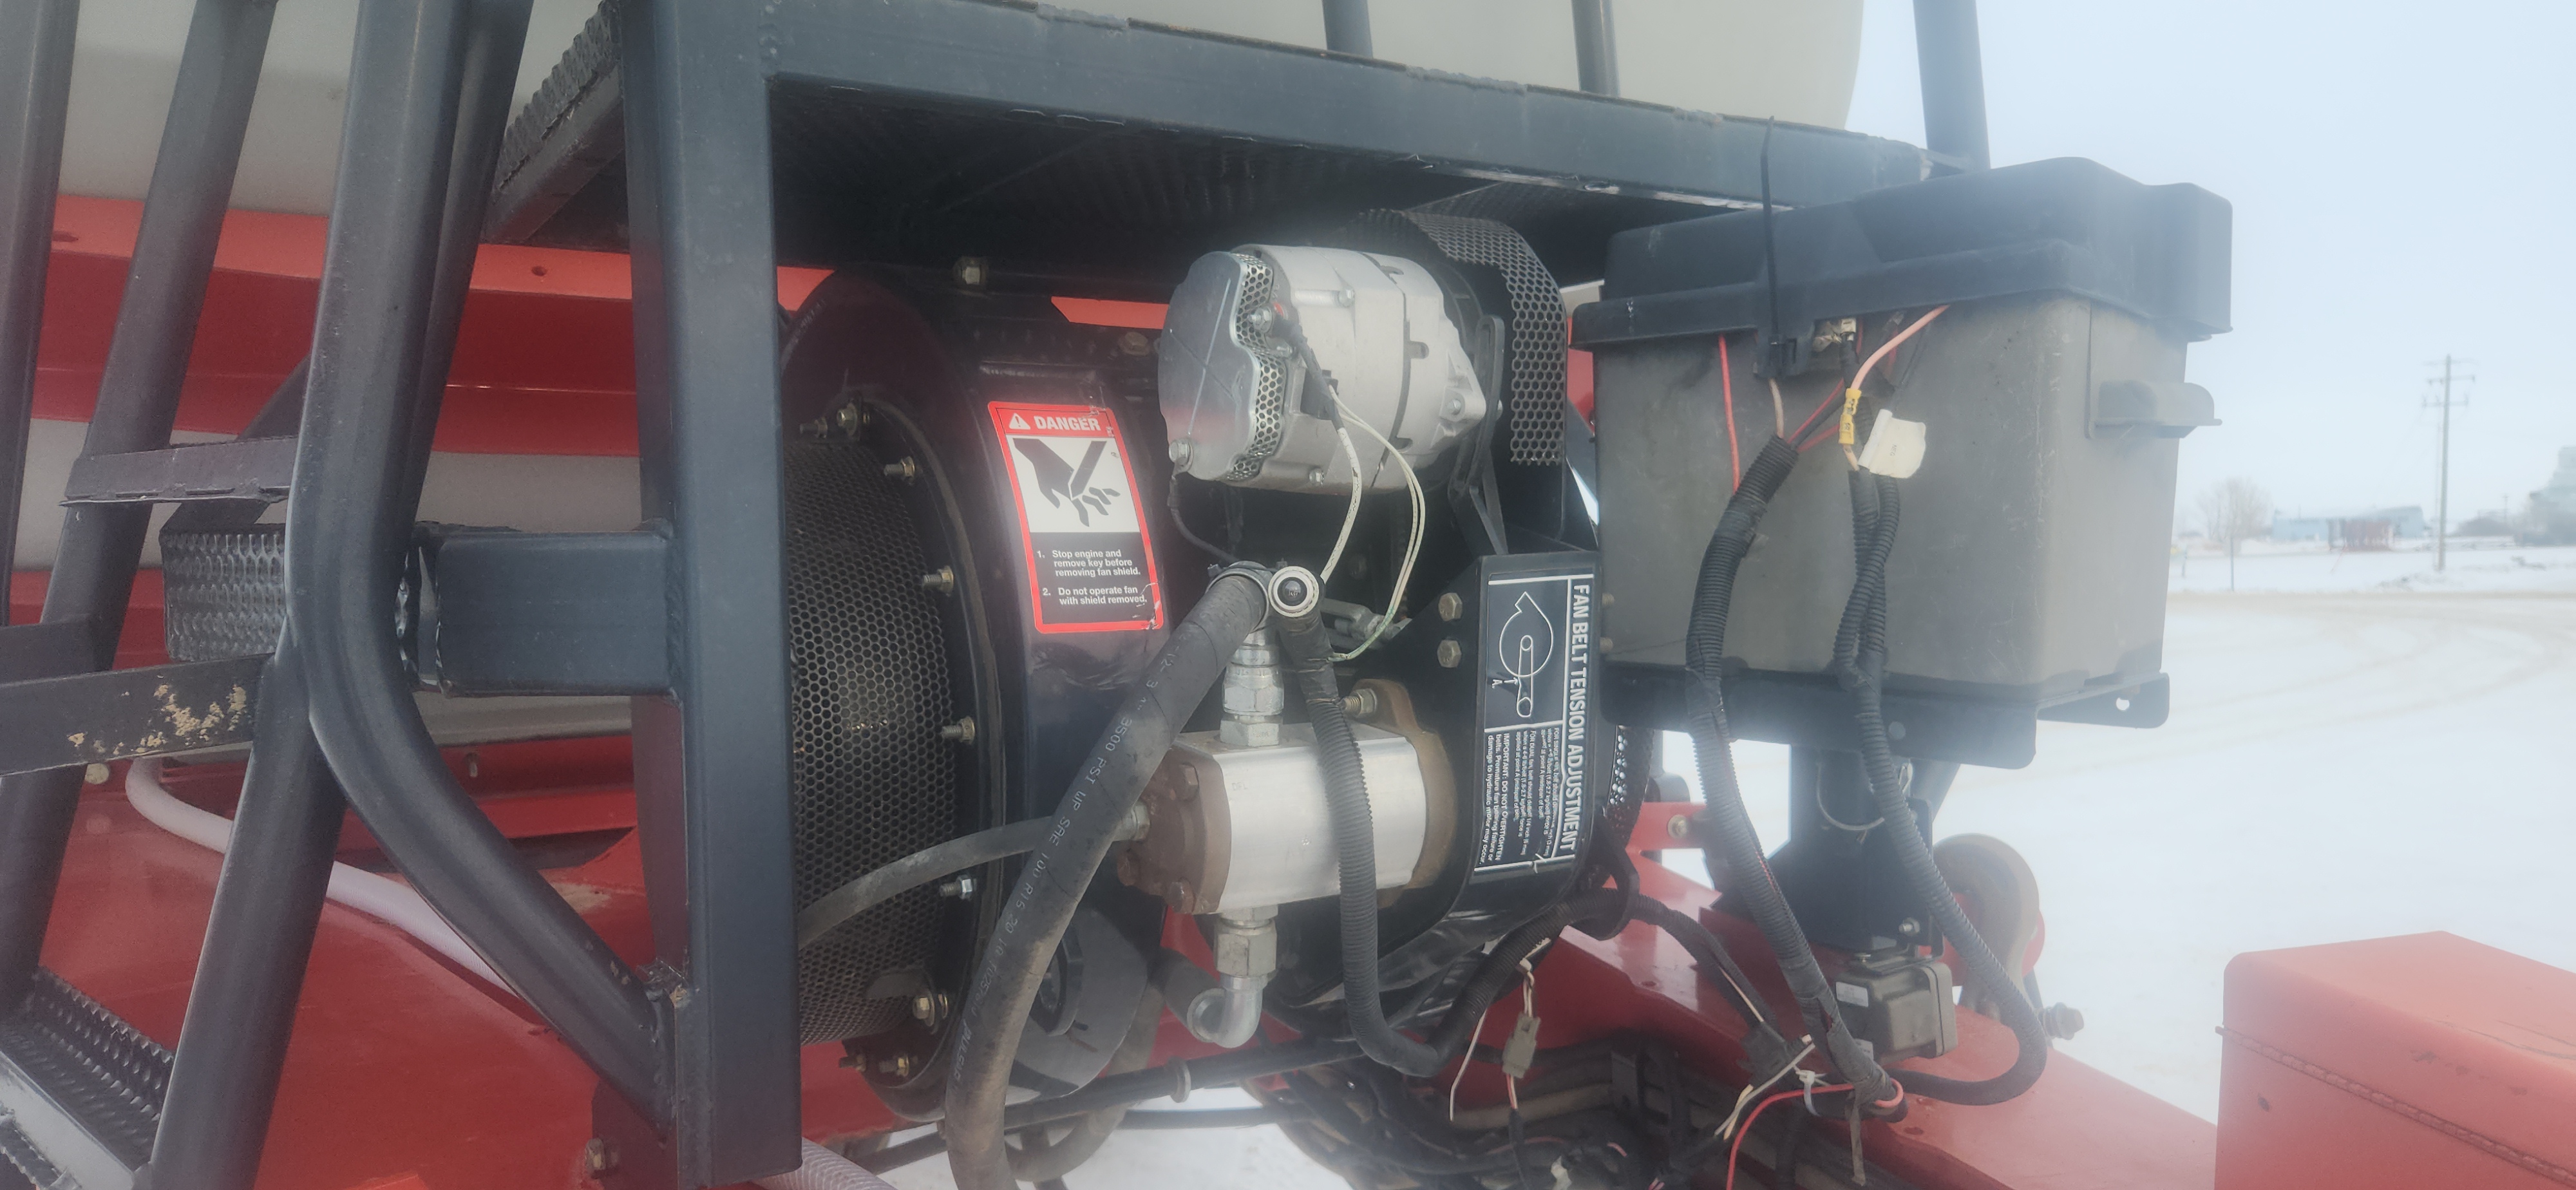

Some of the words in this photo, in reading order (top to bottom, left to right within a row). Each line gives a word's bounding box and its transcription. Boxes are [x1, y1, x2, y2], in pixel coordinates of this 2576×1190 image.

[1034, 415, 1101, 431] DANGER
[1052, 550, 1073, 559] Stop
[1074, 551, 1104, 559] engine
[1088, 560, 1104, 568] key
[1055, 569, 1095, 577] removing
[1089, 587, 1122, 596] operate
[1124, 585, 1138, 594] fan
[1108, 595, 1147, 603] removed.
[1572, 584, 1589, 619] FAN
[1571, 623, 1588, 665] BELT
[1568, 667, 1586, 740] TENSION
[1105, 716, 1132, 751] 3500
[1501, 733, 1510, 779] IMPORTANT:
[1084, 757, 1106, 784] PSI
[1484, 773, 1493, 806] hydraulic
[1501, 780, 1508, 792] DO
[1561, 744, 1584, 851] ADJUSTMENT
[1073, 791, 1086, 811] WP
[1048, 815, 1070, 846] SAE
[1491, 806, 1500, 831] bearing
[1481, 828, 1490, 843] may
[1490, 832, 1498, 853] failure
[1495, 811, 1508, 861] OVERTIGHTEN
[1032, 853, 1050, 878] 100
[1479, 844, 1488, 865] occur.
